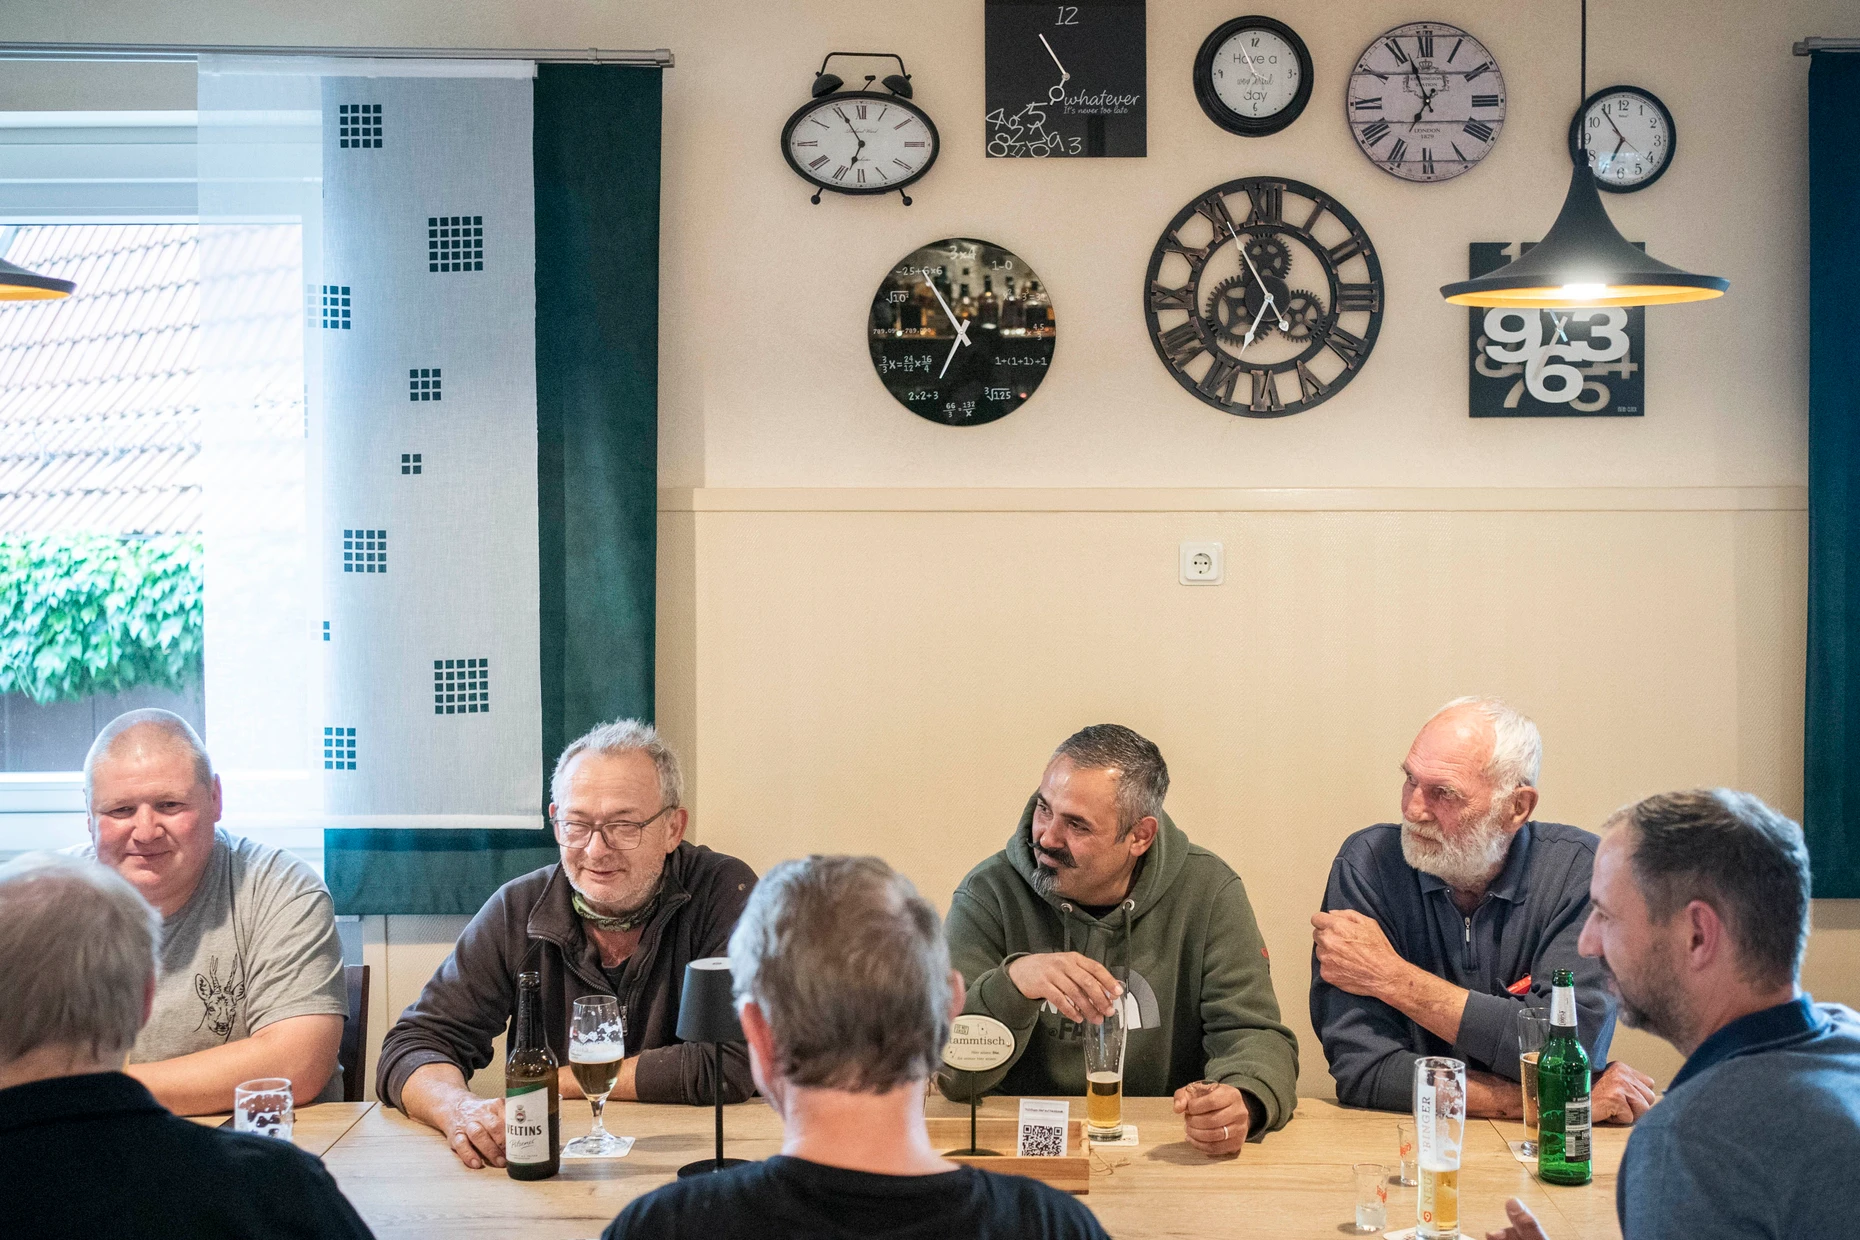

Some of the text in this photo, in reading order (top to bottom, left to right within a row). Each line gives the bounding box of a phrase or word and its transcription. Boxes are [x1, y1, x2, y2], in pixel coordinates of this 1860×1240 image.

[1055, 6, 1079, 25] 12
[1251, 38, 1260, 47] 12
[1416, 30, 1433, 58] XII
[1233, 53, 1277, 64] Have a
[1064, 89, 1140, 106] whatever
[1244, 91, 1267, 102] day
[1063, 106, 1076, 114] It's
[1100, 106, 1112, 114] too
[1113, 106, 1129, 114] late
[1603, 104, 1611, 115] 11
[1617, 100, 1630, 111] 12
[1639, 105, 1643, 116] 1
[985, 108, 1004, 130] 4
[1589, 116, 1600, 128] 10
[1650, 118, 1657, 128] 2
[1068, 137, 1082, 155] 3
[1654, 135, 1661, 147] 3
[1588, 150, 1596, 161] 8
[1646, 151, 1653, 163] 4
[1617, 167, 1624, 179] 6
[1635, 163, 1642, 175] 5
[1243, 182, 1287, 228] XII
[1194, 191, 1241, 243] XI
[1297, 196, 1331, 239] I
[1162, 229, 1210, 274] X
[1321, 228, 1371, 274] II
[1150, 280, 1195, 312] IX
[1336, 280, 1379, 313] III
[1484, 308, 1543, 363] 9
[1571, 307, 1630, 362] 3
[1196, 352, 1241, 407] VII
[1297, 360, 1330, 404] V
[1525, 345, 1584, 403] 6
[1250, 369, 1286, 412] VI
[949, 1035, 1005, 1046] tammtisch
[507, 1124, 542, 1137] VELTINS
